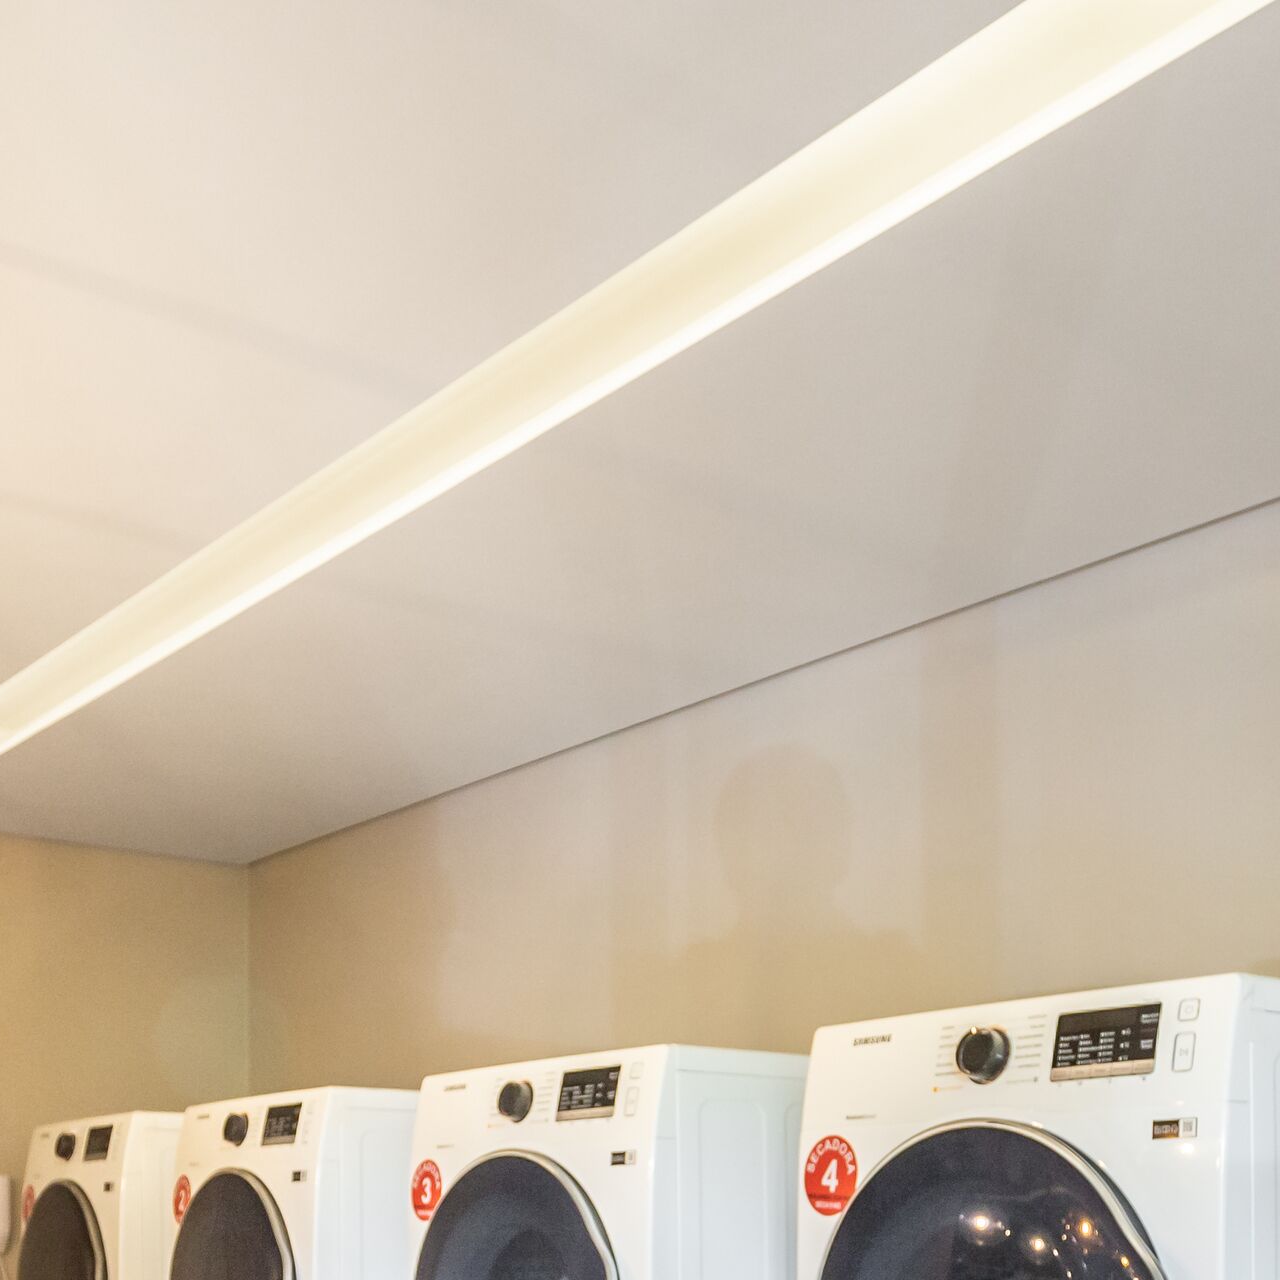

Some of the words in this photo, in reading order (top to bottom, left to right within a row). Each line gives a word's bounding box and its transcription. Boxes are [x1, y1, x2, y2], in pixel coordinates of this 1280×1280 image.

[807, 1138, 855, 1175] SECADORA
[421, 1177, 432, 1204] 3
[821, 1159, 839, 1193] 4
